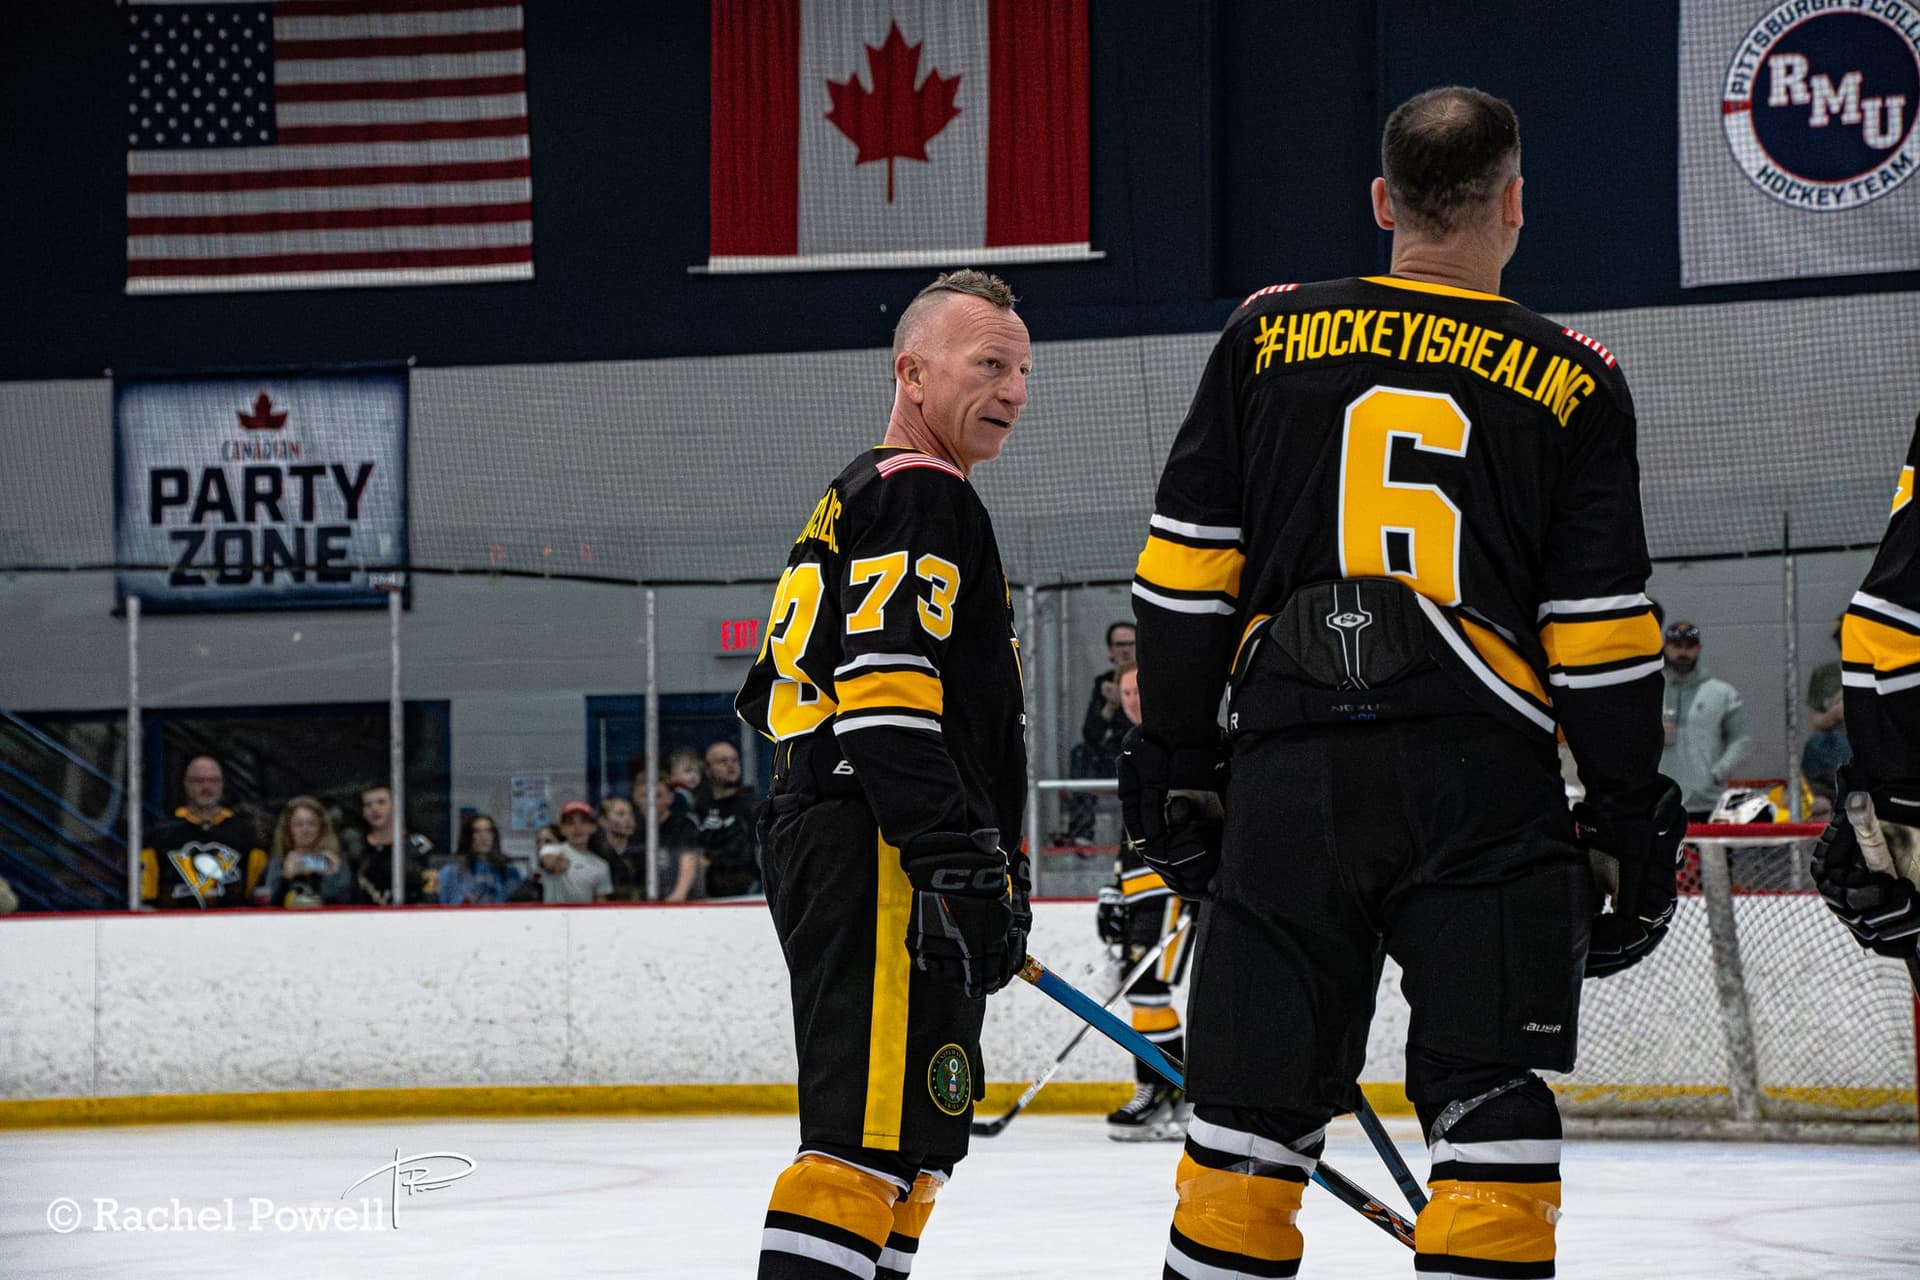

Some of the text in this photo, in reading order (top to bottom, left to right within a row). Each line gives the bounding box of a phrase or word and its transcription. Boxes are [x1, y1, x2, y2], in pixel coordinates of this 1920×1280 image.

[1730, 0, 1862, 95] PITTSBURGH
[1767, 53, 1907, 149] RMU
[1757, 151, 1914, 206] HOCKEY TEAM
[1254, 308, 1596, 428] #HOCKEYISHEALING
[150, 462, 375, 525] PARTY
[1337, 384, 1472, 608] 6
[169, 526, 352, 587] ZONE
[846, 550, 961, 641] 73
[721, 618, 760, 651] EXIT
[1522, 1021, 1562, 1034] AUER
